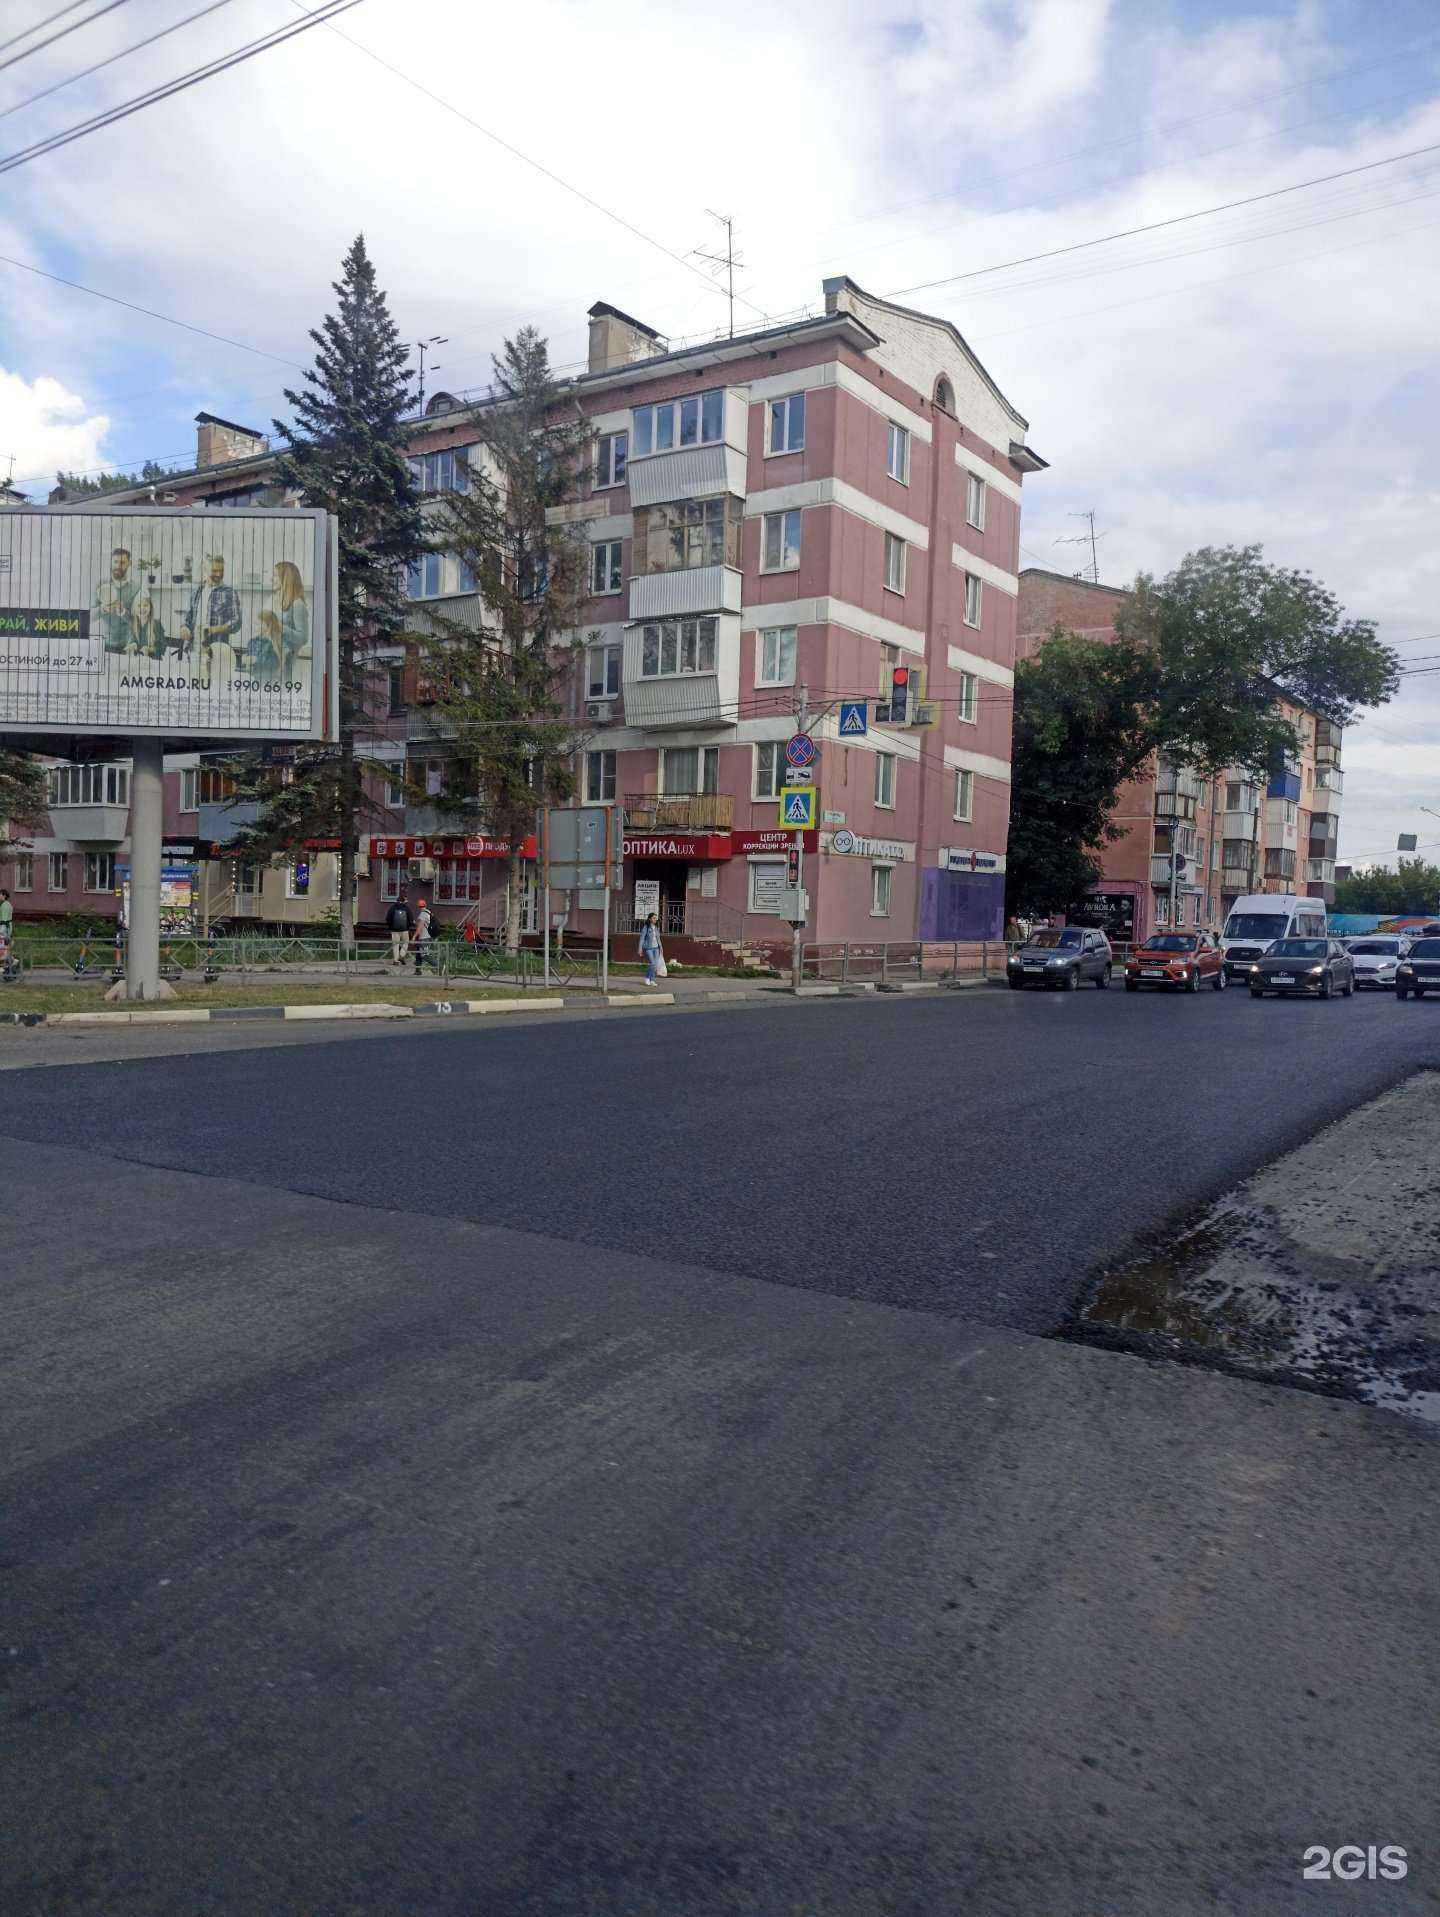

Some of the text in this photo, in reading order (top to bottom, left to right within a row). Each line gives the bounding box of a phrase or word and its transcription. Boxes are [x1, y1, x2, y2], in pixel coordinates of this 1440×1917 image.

[34, 617, 79, 632] ЖИВИ
[53, 657, 67, 666] до
[69, 656, 82, 666] 27
[120, 676, 211, 690] AMGRAD.RU
[234, 680, 260, 692] 990
[264, 681, 281, 693] 66
[285, 681, 302, 694] 99
[760, 833, 787, 843] ЦЕНТР
[622, 841, 678, 855] ОПТИКА
